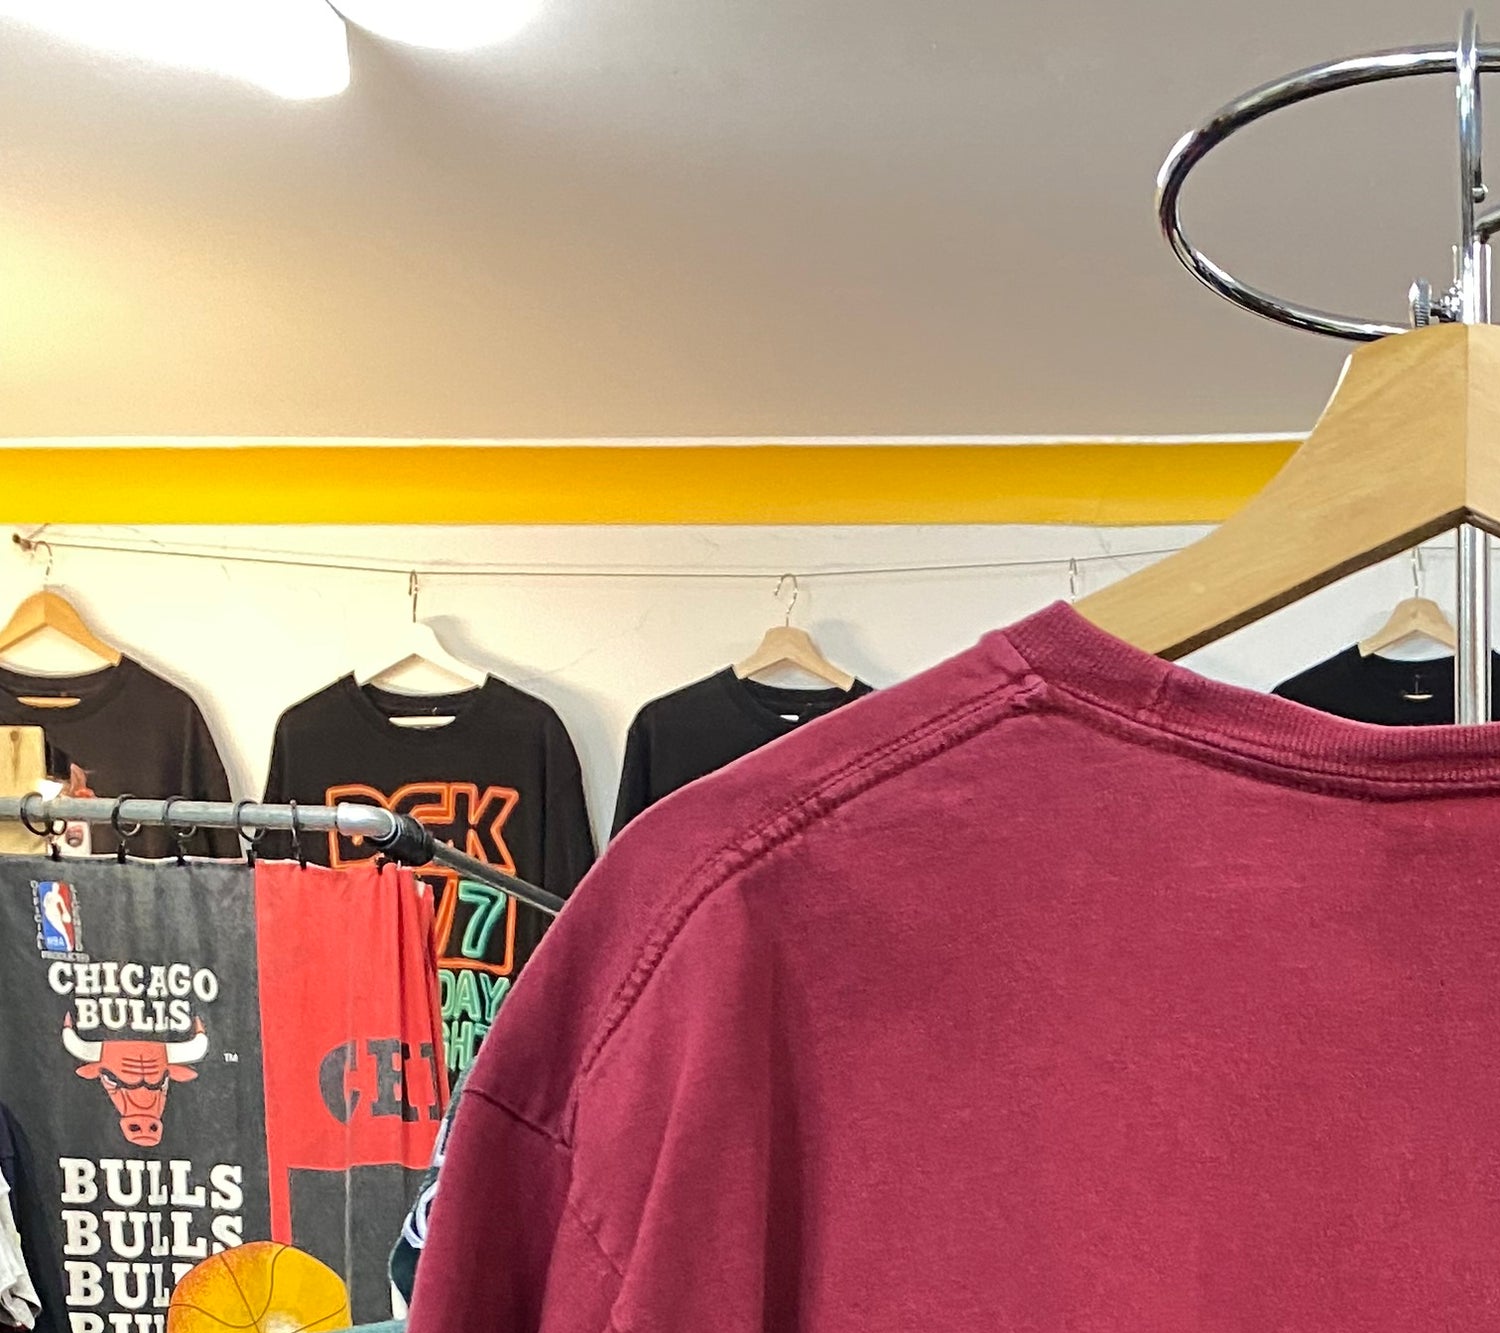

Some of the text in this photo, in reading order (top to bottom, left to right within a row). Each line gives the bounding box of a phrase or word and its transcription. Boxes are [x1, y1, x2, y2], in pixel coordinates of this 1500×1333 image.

[48, 961, 219, 1003] CHICAGO
[75, 997, 191, 1032] BULLS
[59, 1157, 244, 1211] BULLS
[64, 1260, 194, 1310] BUL
